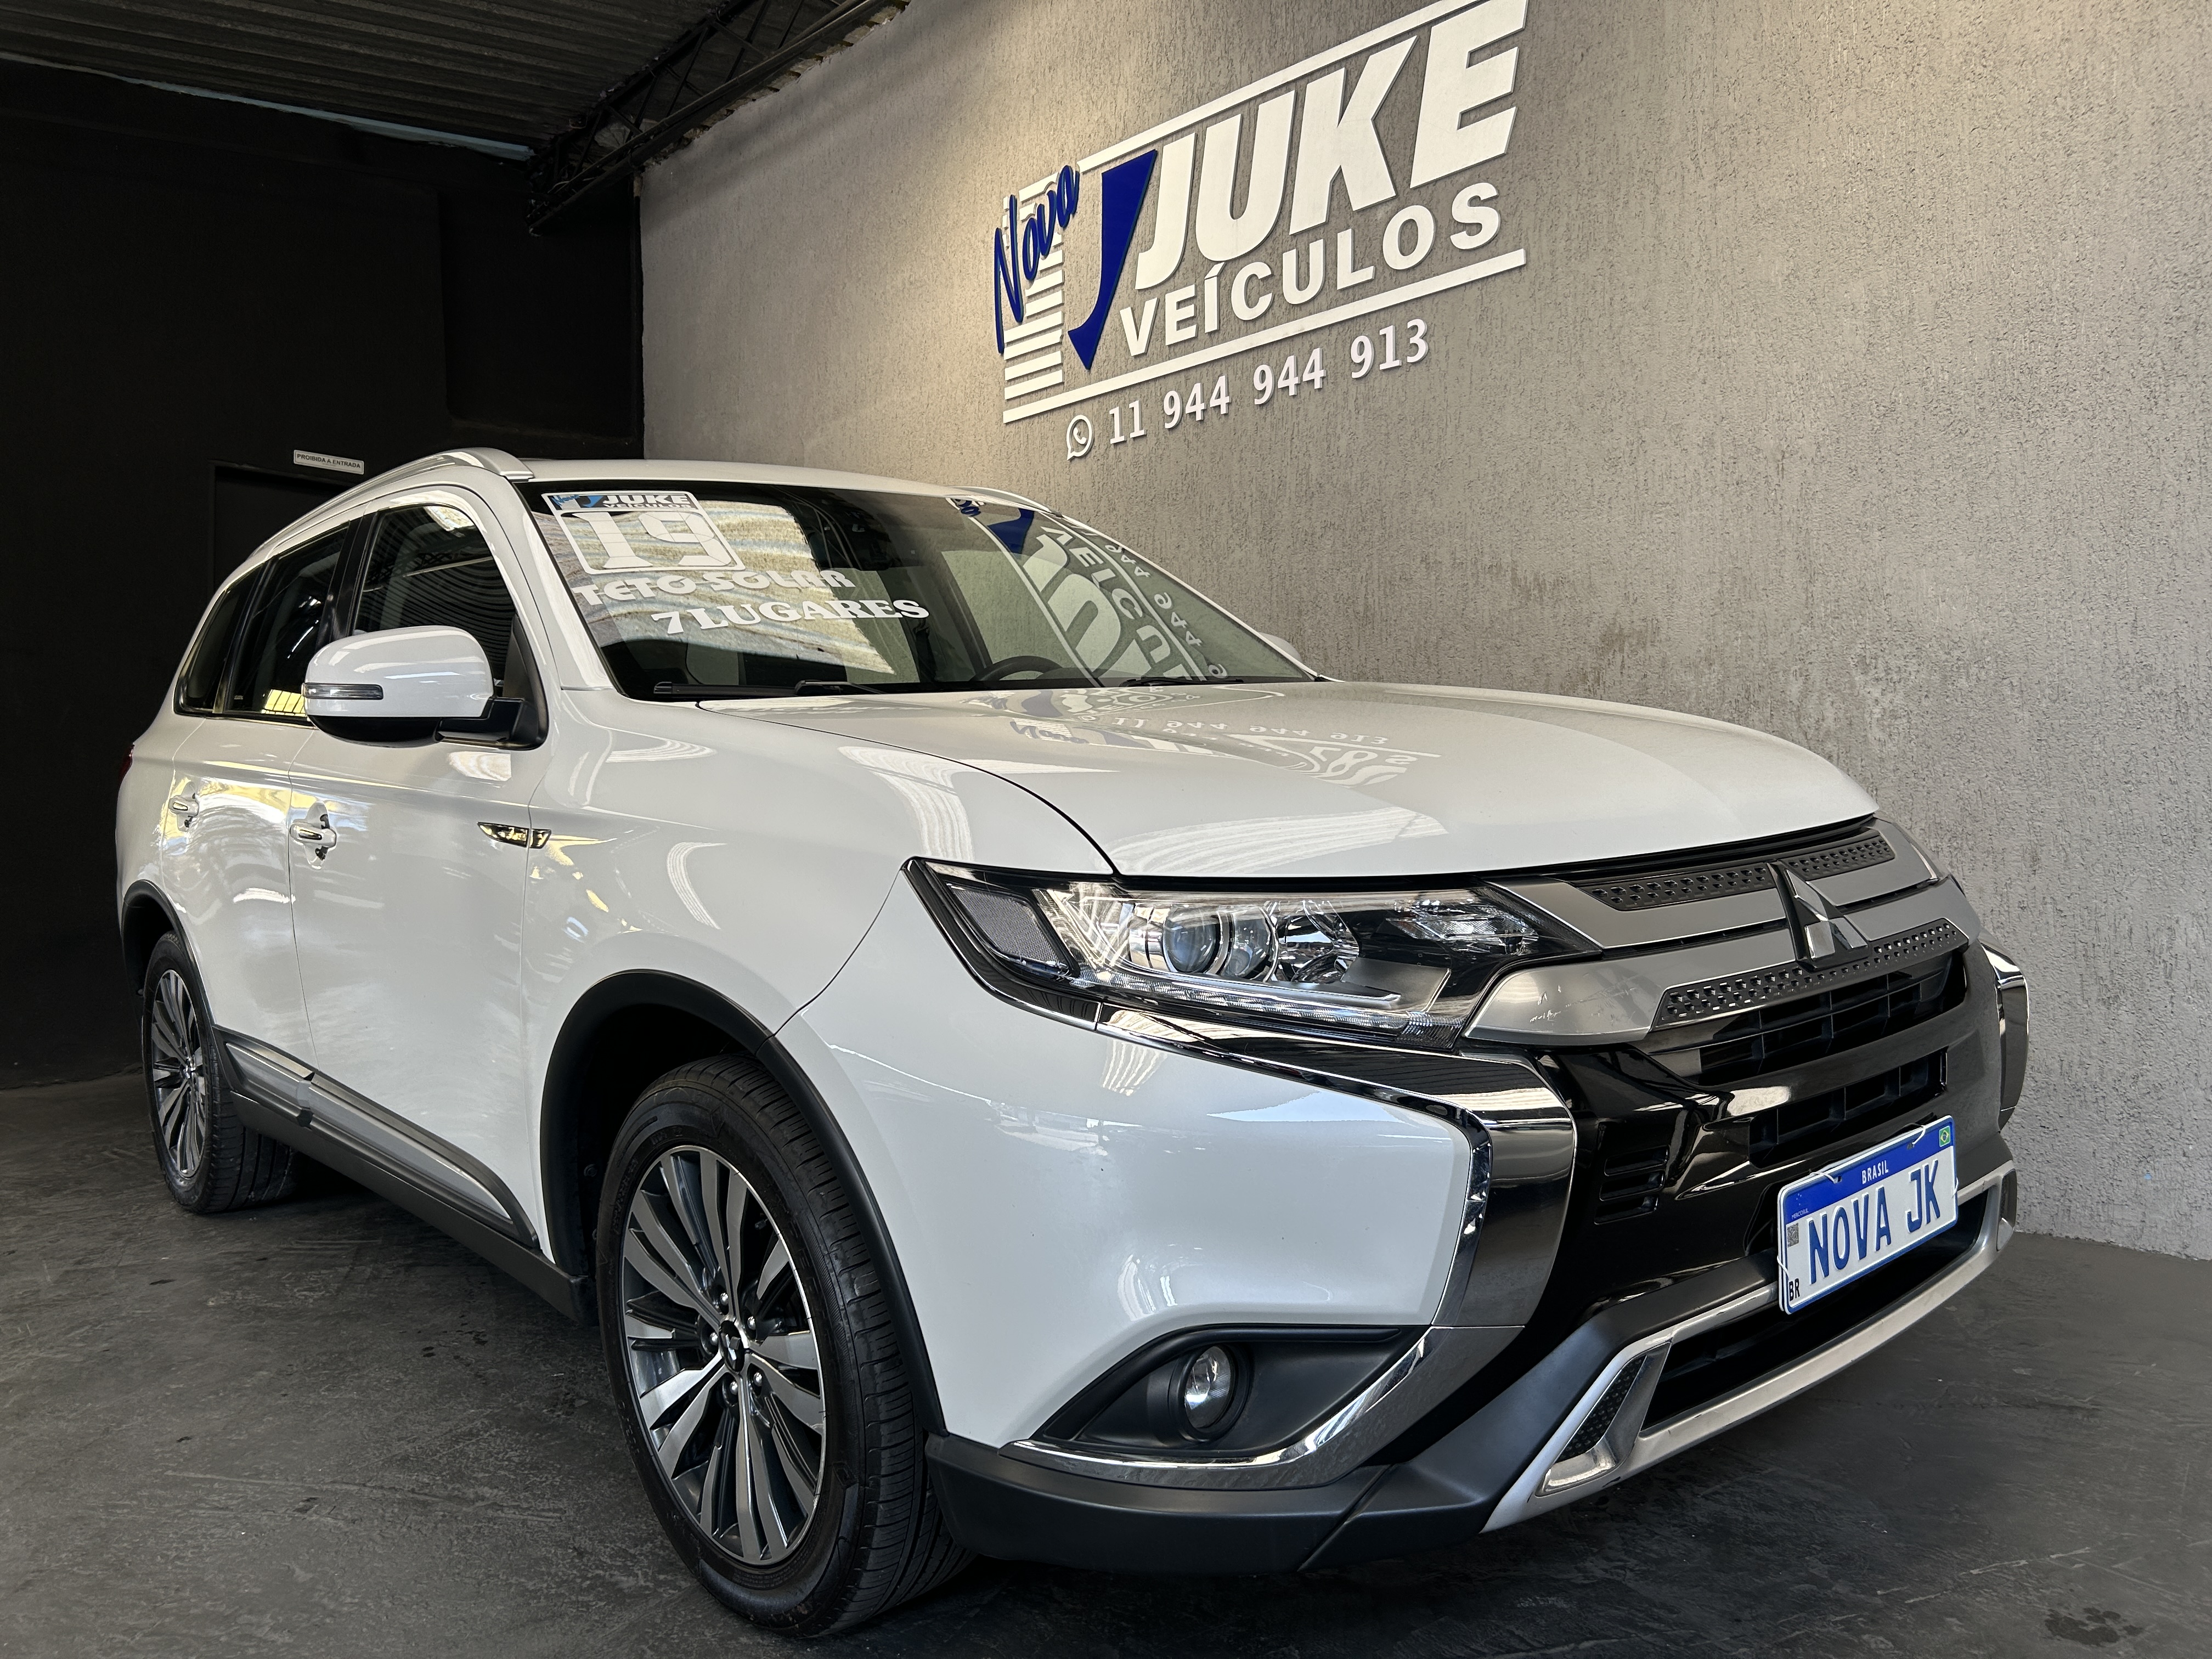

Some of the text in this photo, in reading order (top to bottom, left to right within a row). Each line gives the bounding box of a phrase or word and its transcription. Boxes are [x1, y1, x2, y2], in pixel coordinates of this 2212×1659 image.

[1135, 0, 1528, 290] JUKE
[994, 165, 1080, 354] Nova
[1120, 183, 1500, 357] VEÍCULOS
[1109, 319, 1429, 444] 11 944 944 913
[297, 453, 326, 462] PROIBIDA
[332, 459, 361, 469] ENTRADA
[602, 495, 691, 504] JUKE
[572, 512, 731, 568] 19
[571, 570, 856, 606] TETO SOLAR
[1861, 1160, 1889, 1184] BRASIL
[1807, 1159, 1940, 1285] NOVA JK
[1789, 1278, 1800, 1301] BR
